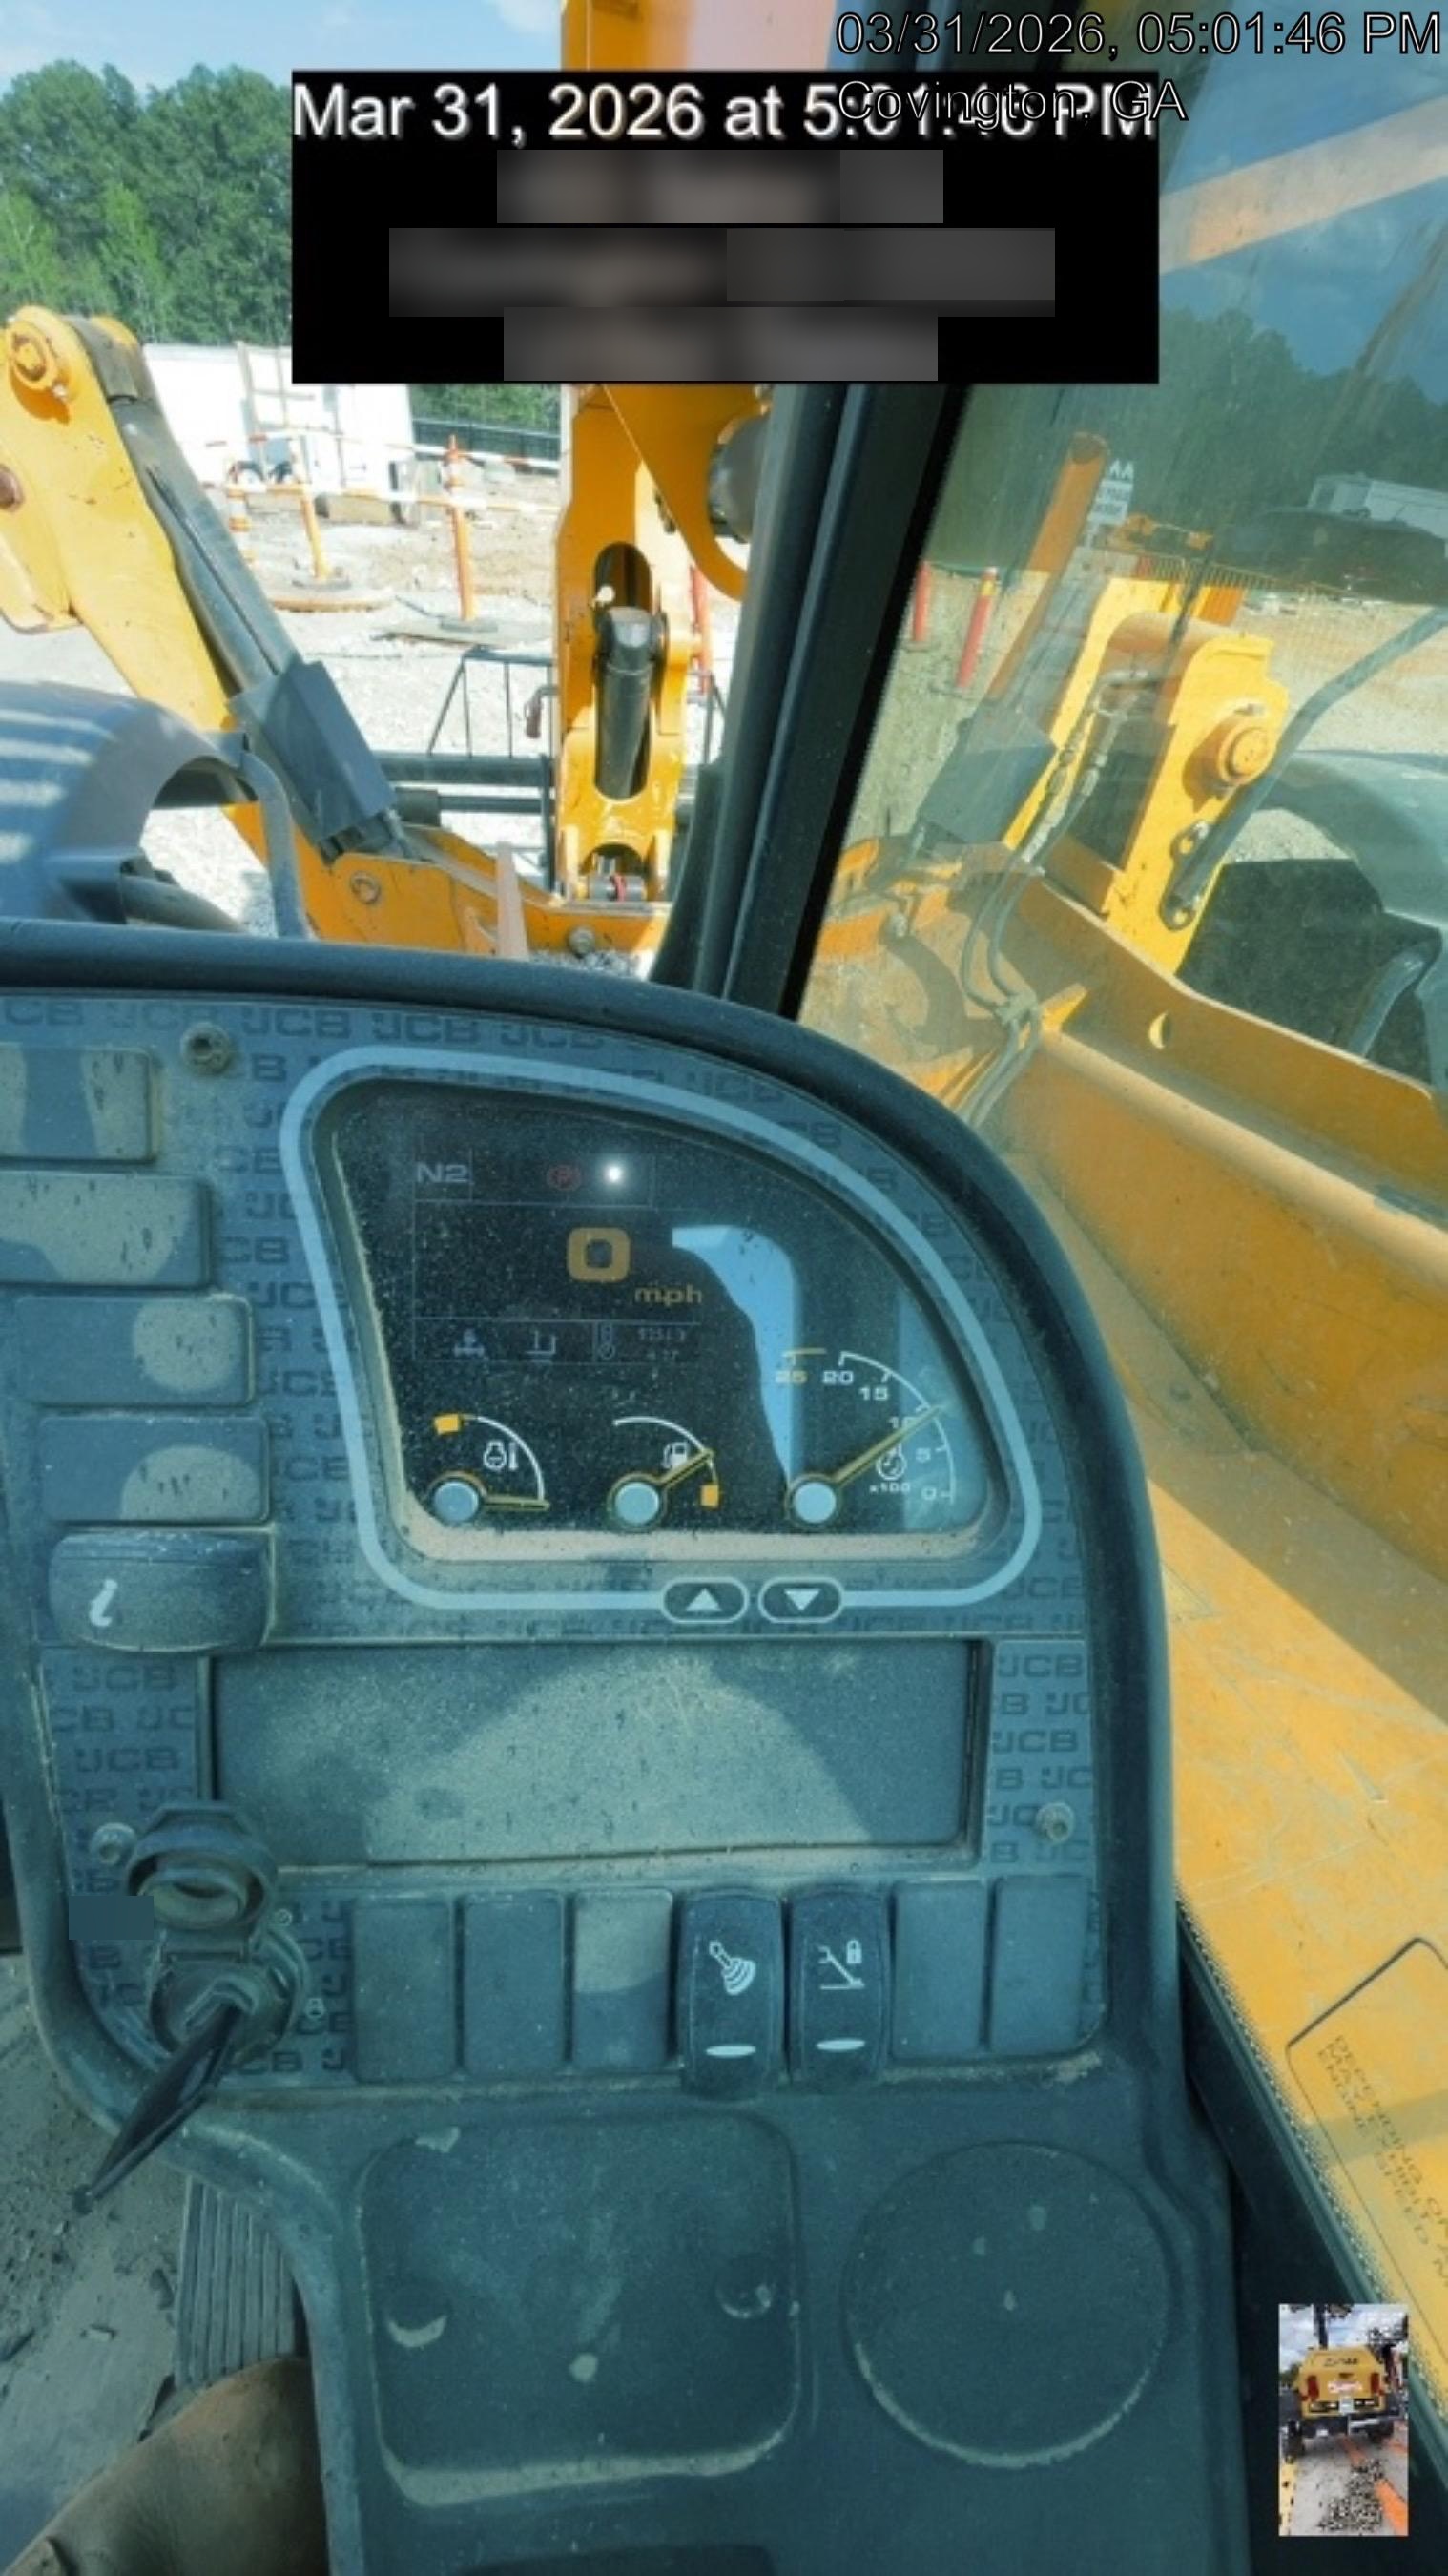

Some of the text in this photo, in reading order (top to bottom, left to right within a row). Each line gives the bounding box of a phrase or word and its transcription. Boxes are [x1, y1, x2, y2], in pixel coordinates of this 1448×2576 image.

[3, 1002, 84, 1027] CB
[241, 1008, 350, 1040] JCB
[372, 1011, 480, 1044] JCB
[416, 1162, 469, 1184] N2
[566, 1227, 631, 1282] 0
[633, 1286, 703, 1307] mph
[775, 1370, 808, 1384] 25
[822, 1370, 855, 1384] 20
[859, 1387, 890, 1401] 15
[915, 1447, 931, 1463] 5
[921, 1486, 937, 1501] 0
[997, 1653, 1084, 1678] JCB
[73, 1665, 176, 1693] JCB
[1045, 1692, 1090, 1715] JC
[137, 1704, 197, 1731] JC
[993, 1729, 1079, 1755] JCB
[75, 1748, 178, 1772] JCB
[1041, 1766, 1091, 1790] JC
